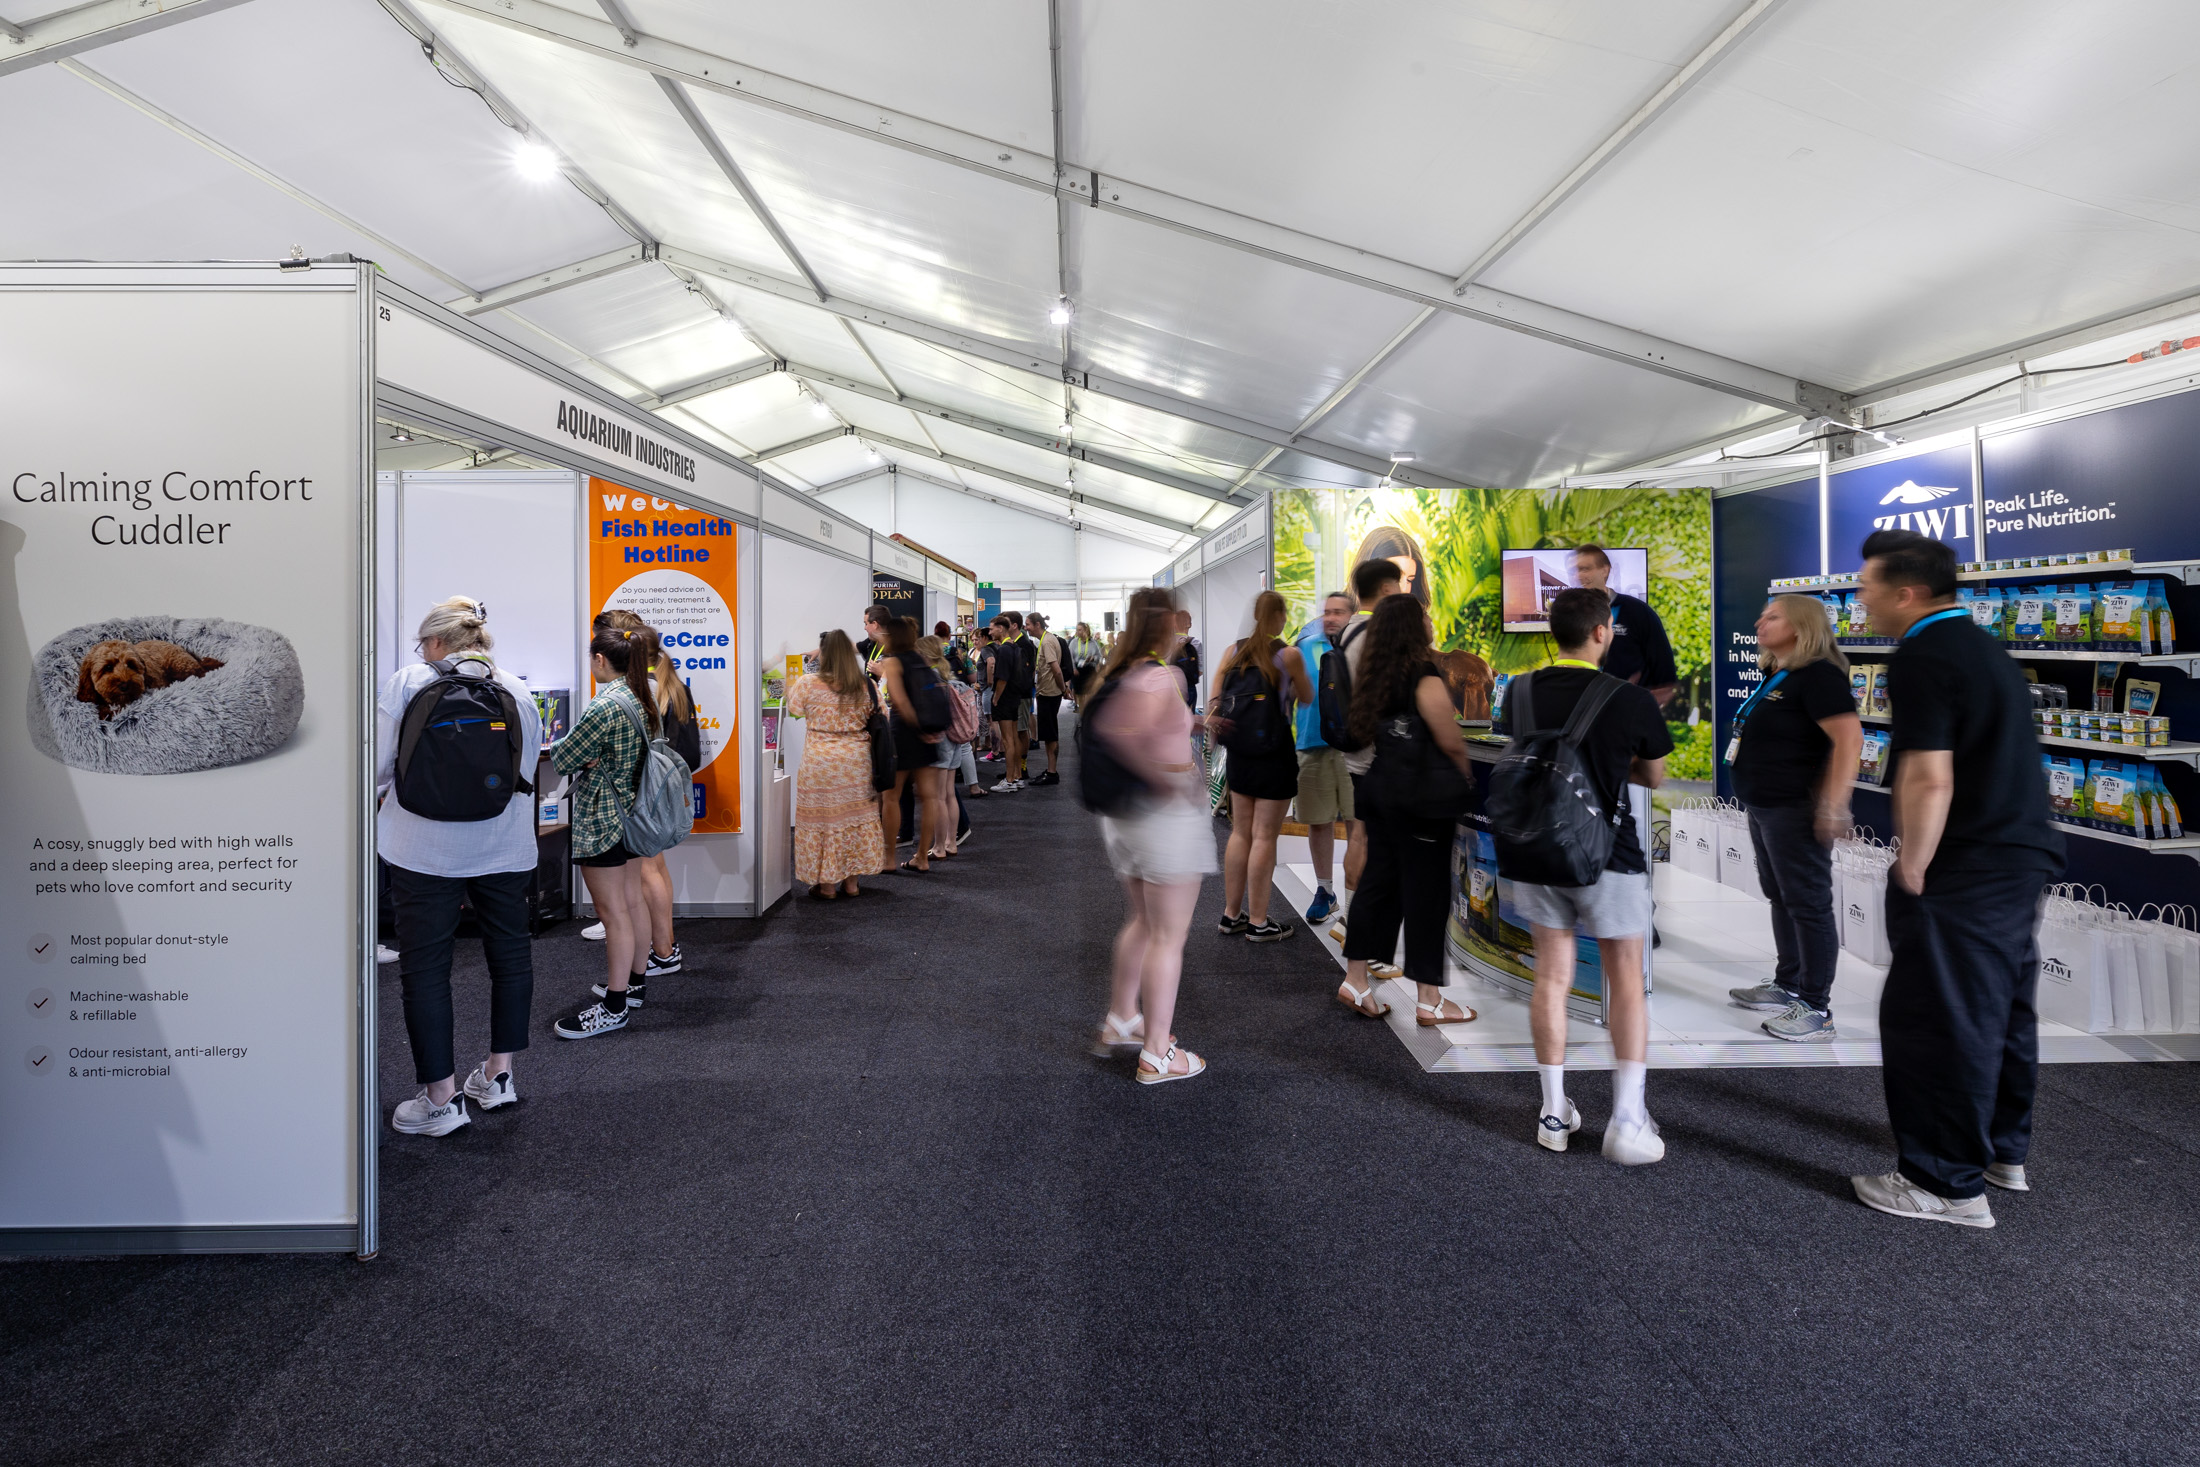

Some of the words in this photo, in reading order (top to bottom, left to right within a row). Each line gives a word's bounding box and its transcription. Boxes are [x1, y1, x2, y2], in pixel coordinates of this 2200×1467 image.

[378, 306, 391, 322] 25
[557, 400, 632, 458] AQUARIUM
[635, 434, 696, 483] INDUSTRIES
[12, 471, 153, 511] Calming
[161, 469, 313, 502] Comfort
[1984, 494, 2027, 515] Peak
[2029, 489, 2070, 509] Life.
[90, 513, 232, 546] Cuddler
[601, 519, 647, 538] Fish
[653, 518, 732, 537] Health
[1873, 503, 1971, 541] ZIWI
[1985, 518, 2024, 534] Pure
[624, 544, 710, 563] Hotline
[639, 597, 667, 605] quality,
[879, 590, 912, 600] PLAN
[652, 618, 672, 626] signs
[673, 617, 681, 625] of
[682, 617, 708, 625] stress?
[1732, 631, 1757, 645] Prou
[685, 656, 726, 670] can
[1728, 649, 1739, 662] in
[1738, 667, 1762, 681] with
[1727, 685, 1748, 698] and
[32, 837, 45, 850] A
[47, 840, 84, 853] cosy,
[87, 837, 145, 852] snuggly
[148, 836, 177, 850] bed
[180, 835, 213, 849] with
[217, 834, 251, 850] high
[254, 834, 294, 848] walls
[29, 858, 57, 872] and
[60, 861, 69, 872] a
[73, 859, 108, 873] deep
[112, 858, 173, 873] sleeping
[177, 860, 214, 873] area,
[218, 856, 274, 873] perfect
[276, 855, 299, 869] for
[35, 881, 67, 896] pets
[69, 880, 101, 894] who
[104, 880, 134, 893] love
[137, 879, 196, 893] comfort
[198, 878, 228, 893] and
[231, 877, 293, 893] security
[1848, 907, 1865, 921] ZIWI
[70, 934, 102, 946] Most
[104, 933, 153, 948] popular
[154, 933, 229, 947] donut-style
[70, 952, 120, 967] calming
[122, 951, 147, 965] bed
[2042, 961, 2072, 979] ZIWI
[70, 991, 189, 1002] Machine-washable
[69, 1009, 79, 1021] &
[82, 1009, 137, 1021] refillable
[68, 1047, 110, 1059] Odour
[112, 1046, 172, 1060] resistant,
[174, 1045, 248, 1059] anti-allergy
[68, 1066, 79, 1078] &
[81, 1064, 171, 1078] anti-microbial
[427, 1106, 452, 1120] HOKA
